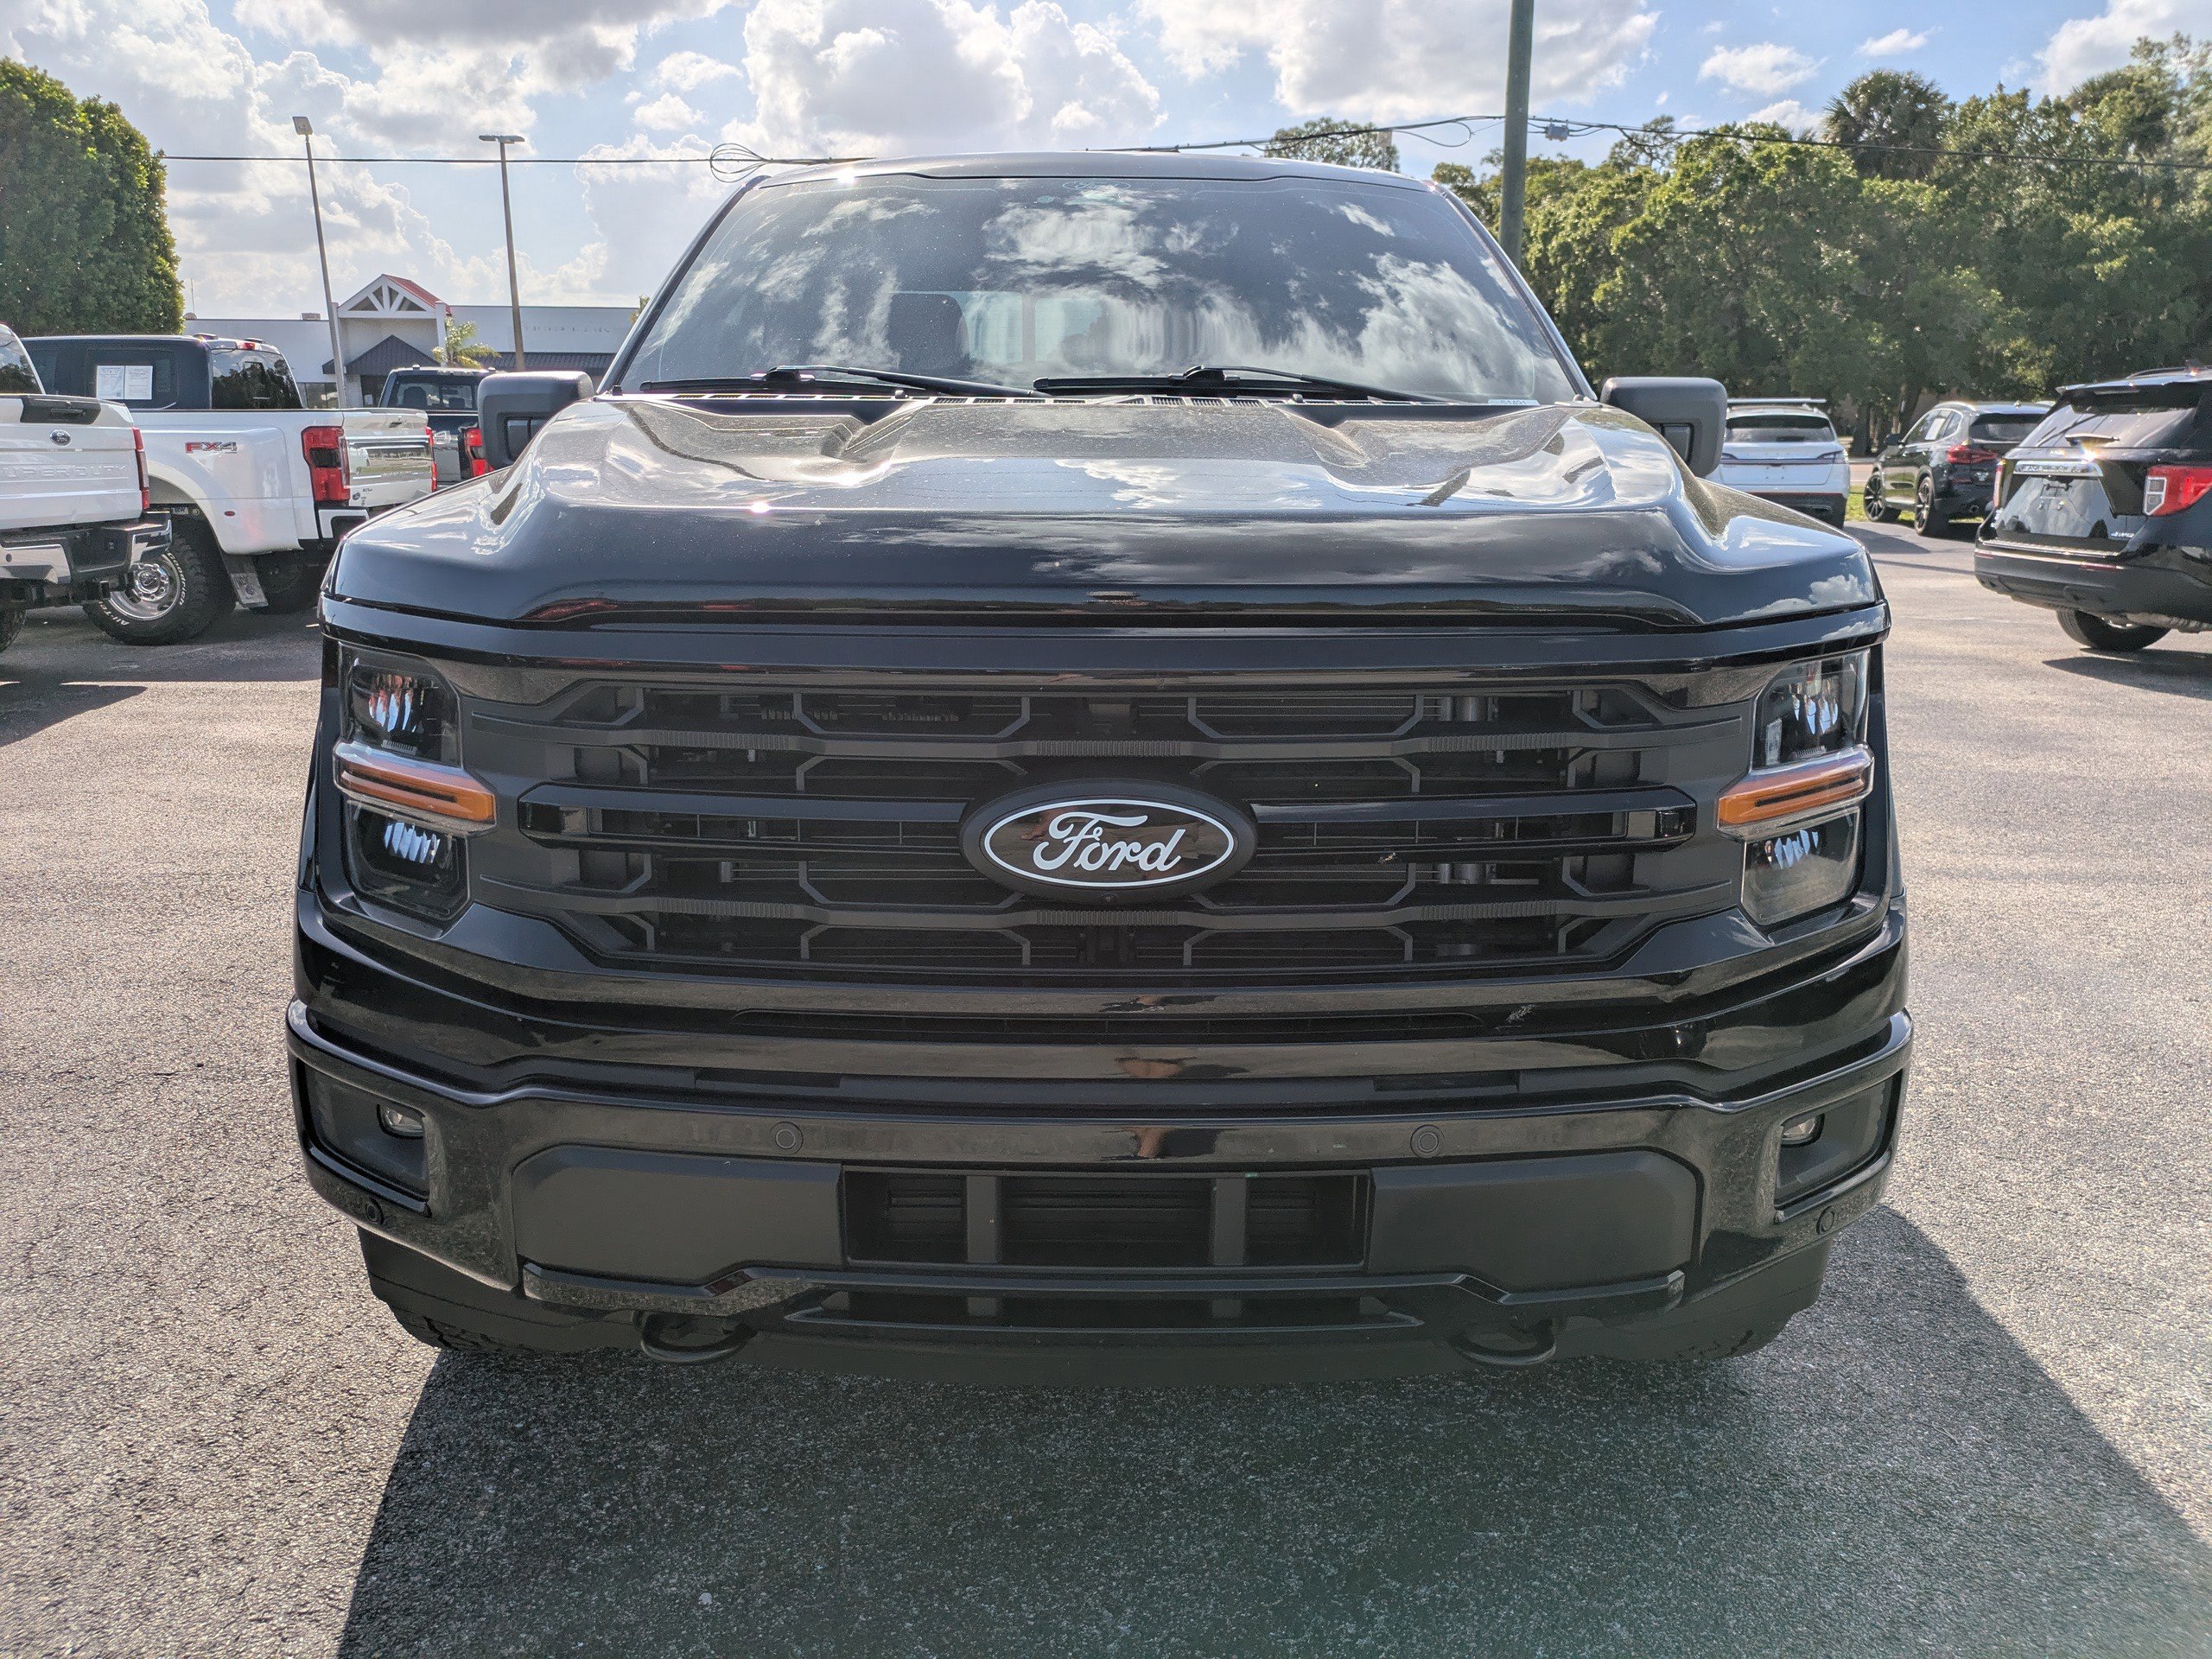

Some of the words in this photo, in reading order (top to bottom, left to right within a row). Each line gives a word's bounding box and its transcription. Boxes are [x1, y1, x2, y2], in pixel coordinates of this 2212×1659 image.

[185, 442, 238, 454] FX4
[3, 465, 71, 478] UPER
[1033, 811, 1186, 871] Ford
